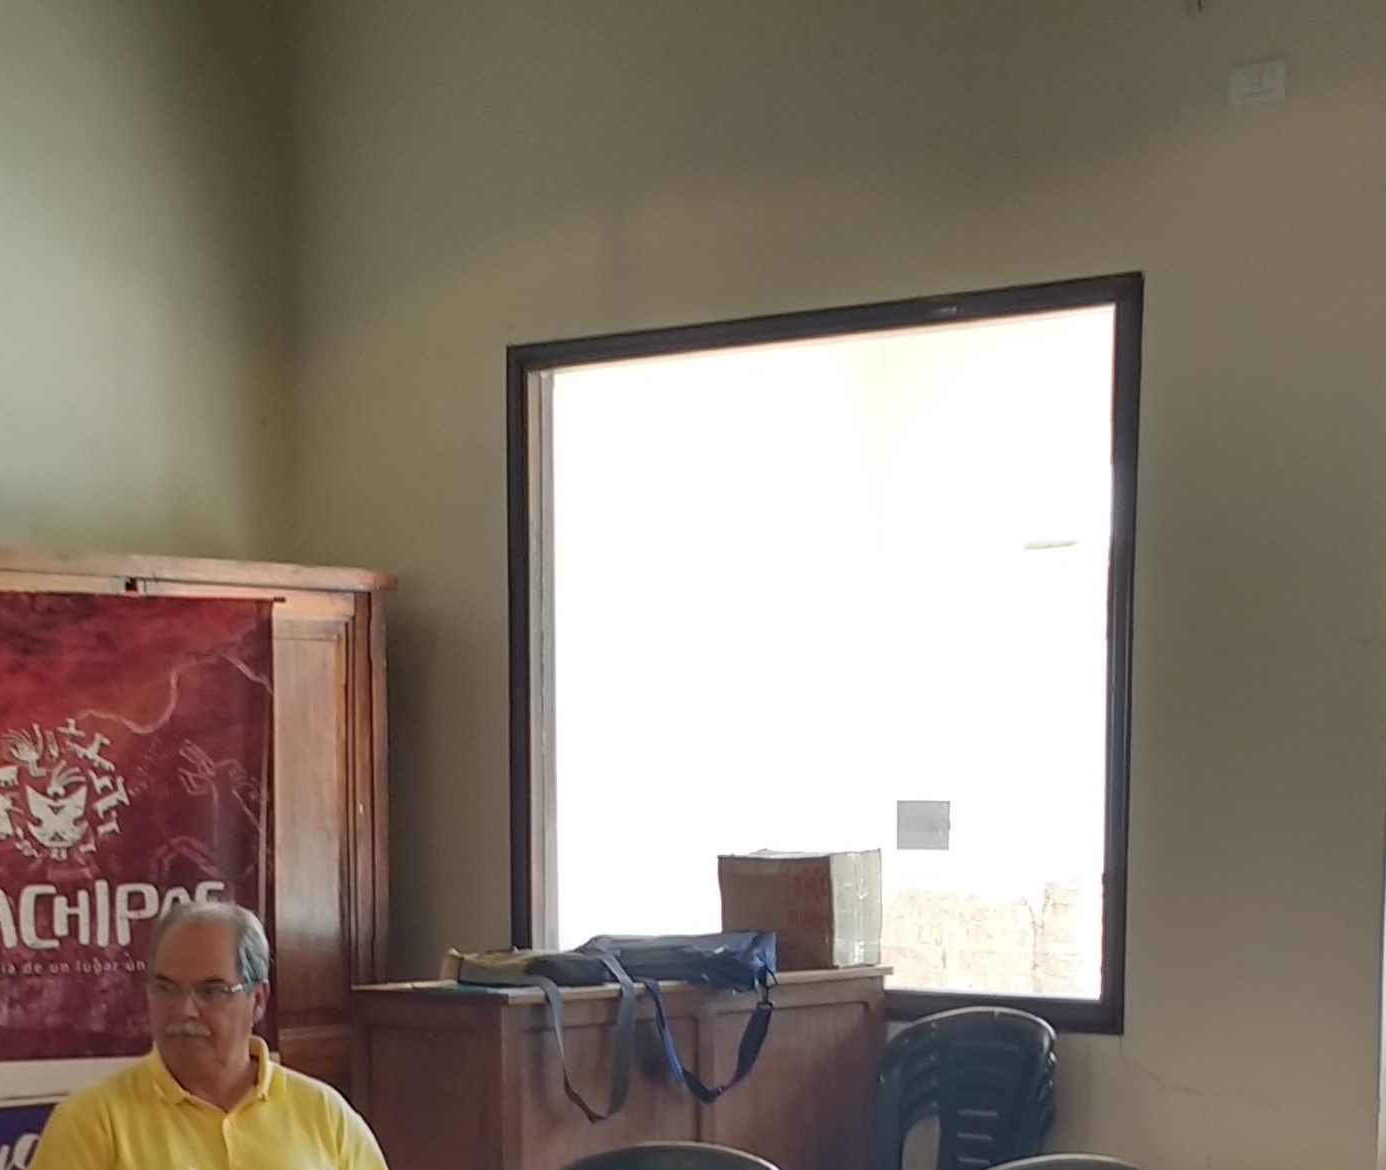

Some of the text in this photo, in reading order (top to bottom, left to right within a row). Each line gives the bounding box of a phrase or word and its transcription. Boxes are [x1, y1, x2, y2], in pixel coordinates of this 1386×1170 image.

[22, 960, 44, 975] de
[49, 961, 71, 974] un
[75, 957, 119, 976] lugar
